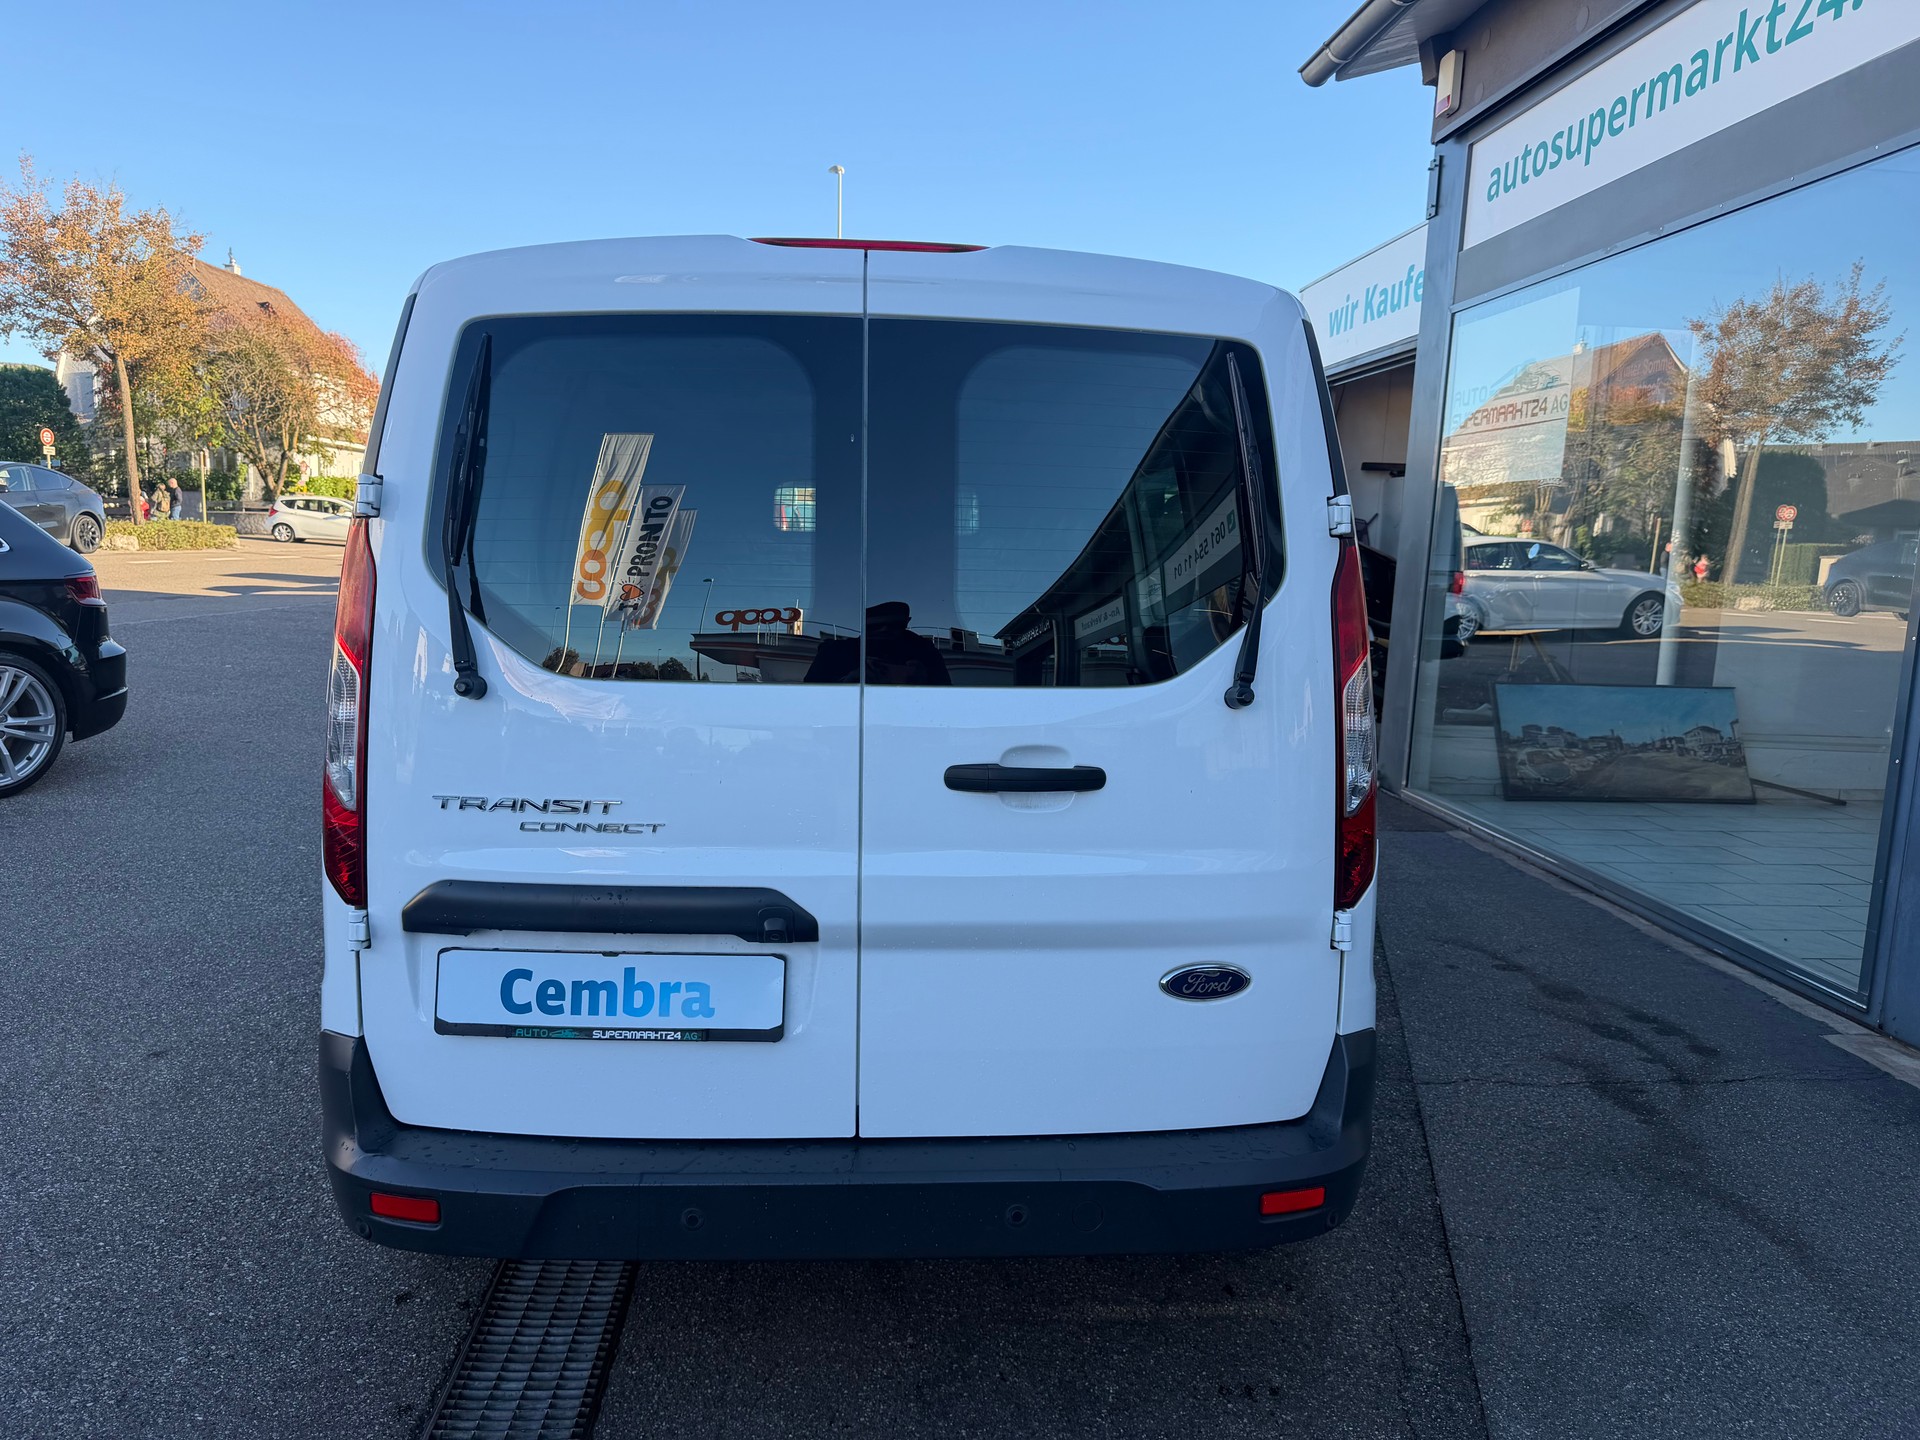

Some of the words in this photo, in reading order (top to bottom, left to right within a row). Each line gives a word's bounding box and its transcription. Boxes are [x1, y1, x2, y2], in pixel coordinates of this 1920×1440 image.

[1328, 293, 1359, 338] wir
[1550, 393, 1568, 414] AG
[576, 480, 630, 600] coop
[626, 495, 674, 577] PRONTO
[432, 795, 623, 816] TRANSIT
[519, 821, 666, 834] CONNECT
[500, 967, 715, 1018] Cembra
[1182, 972, 1233, 994] Ford
[515, 1028, 548, 1037] AUTO
[592, 1030, 681, 1040] SUPERMARKT24
[683, 1032, 698, 1041] AG
